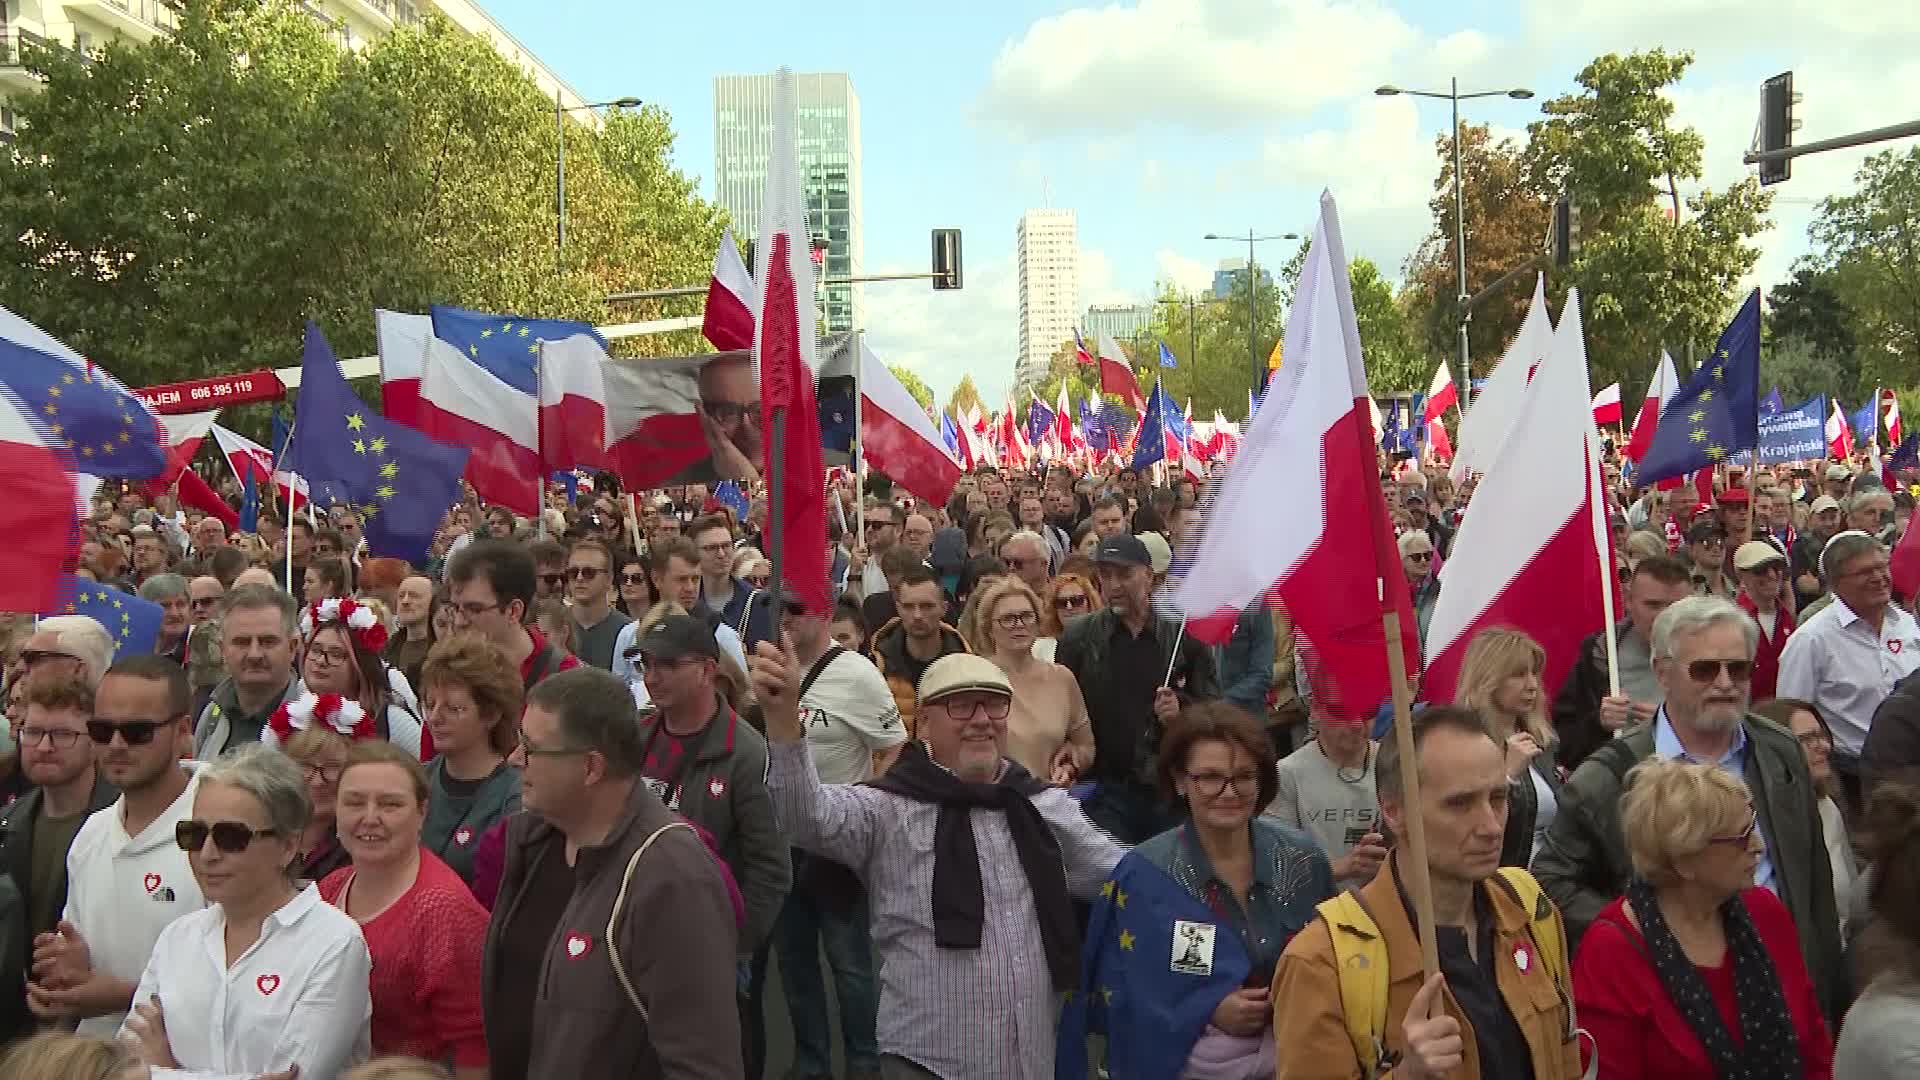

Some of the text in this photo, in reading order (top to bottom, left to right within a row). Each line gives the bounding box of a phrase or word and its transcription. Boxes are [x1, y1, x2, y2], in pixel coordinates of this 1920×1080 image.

[145, 381, 252, 406] AJEM 606 395 119
[1304, 808, 1372, 822] VERS
